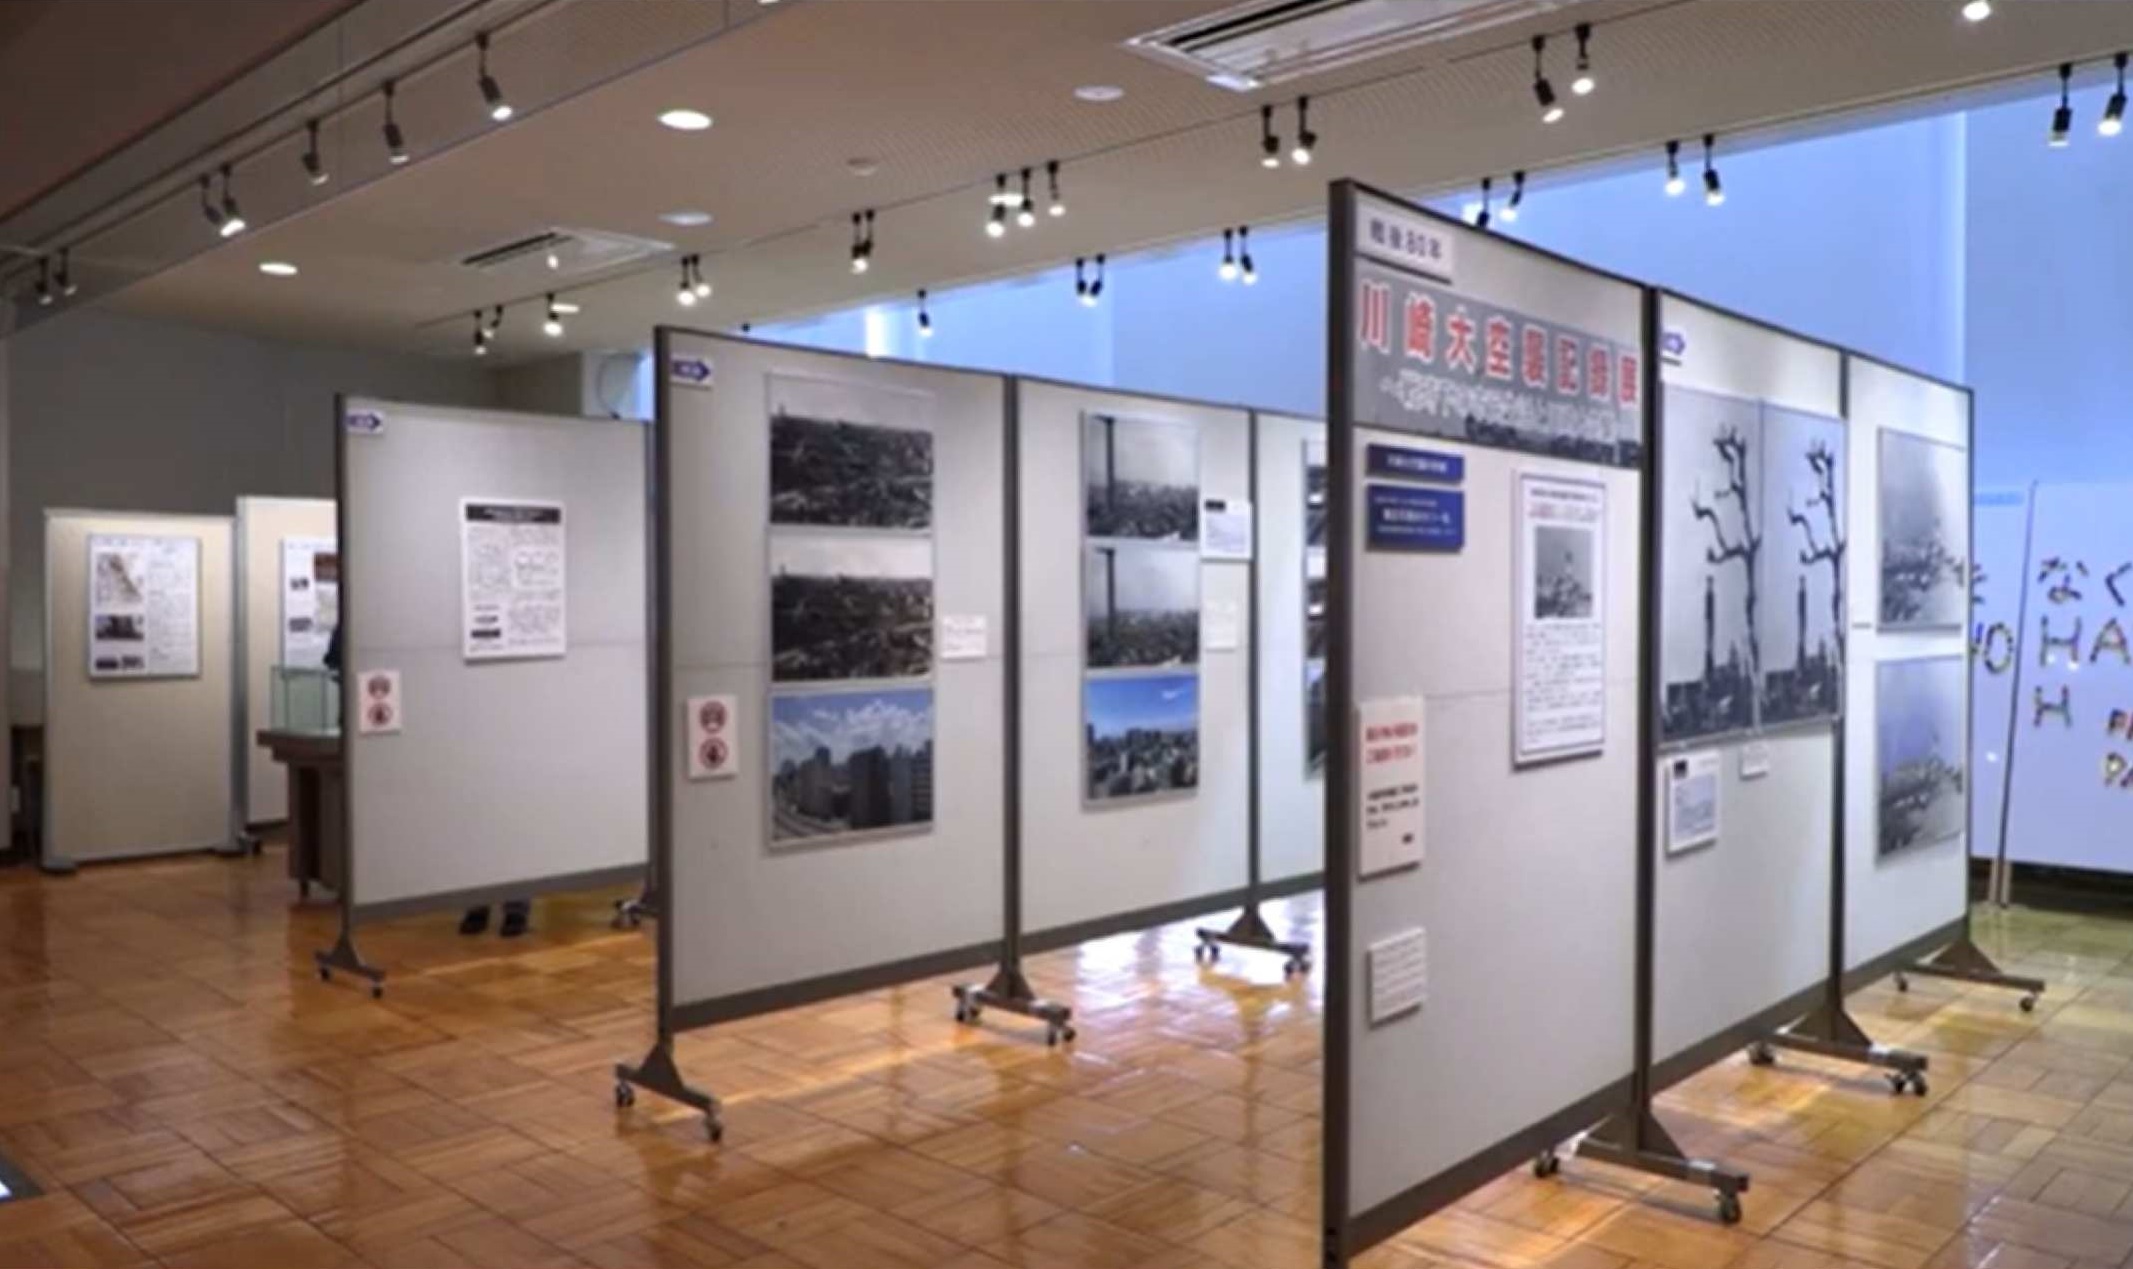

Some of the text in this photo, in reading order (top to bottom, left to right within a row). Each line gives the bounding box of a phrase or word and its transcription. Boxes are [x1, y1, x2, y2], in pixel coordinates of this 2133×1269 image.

[1358, 278, 1641, 406] 川崎大空襲記録展
